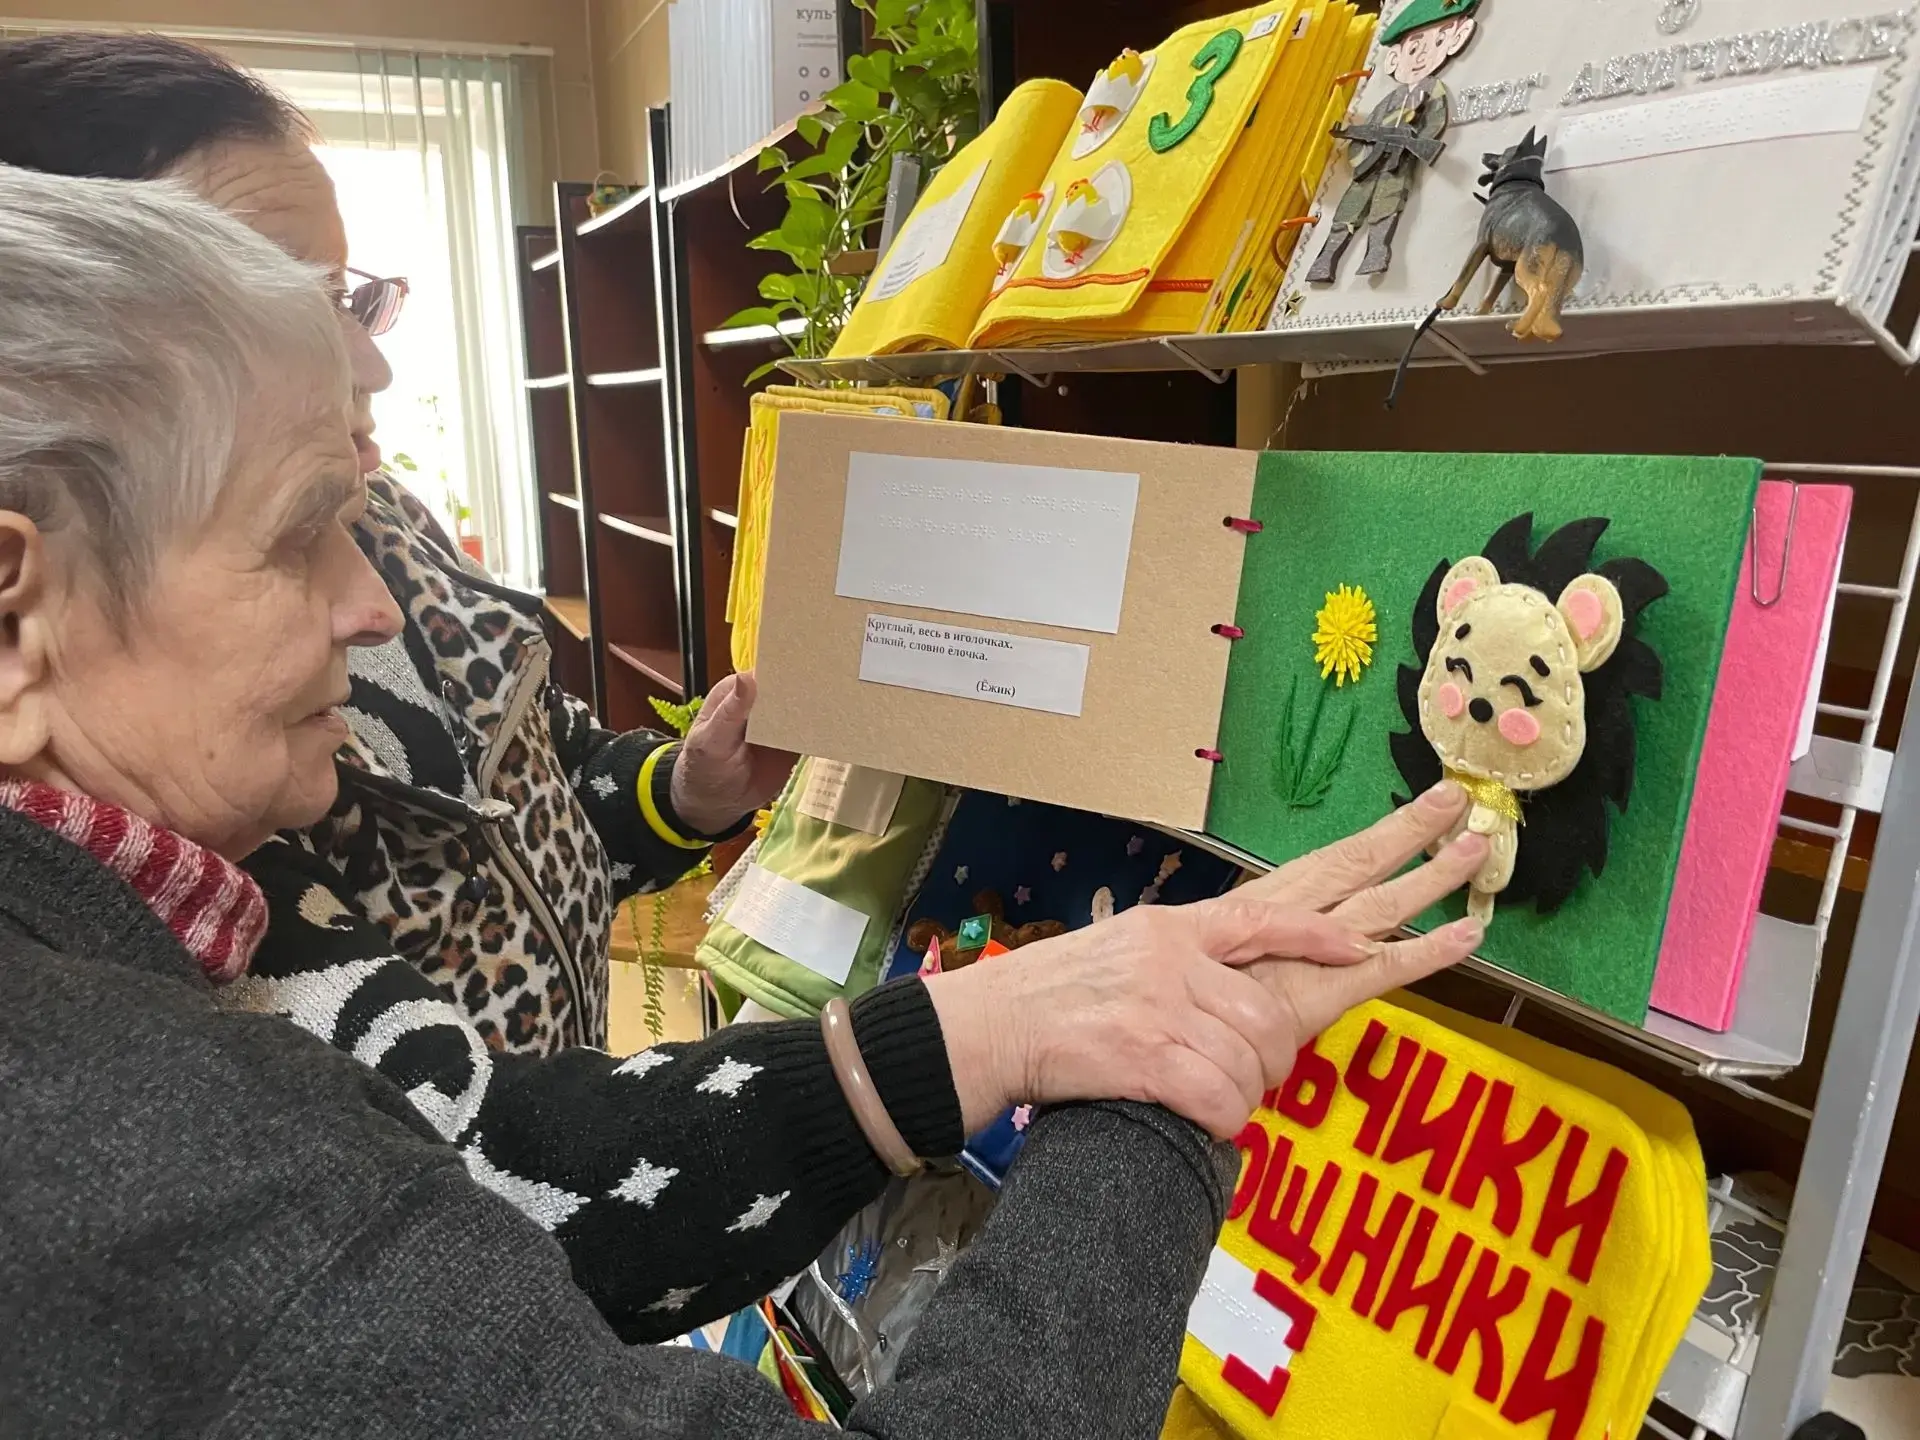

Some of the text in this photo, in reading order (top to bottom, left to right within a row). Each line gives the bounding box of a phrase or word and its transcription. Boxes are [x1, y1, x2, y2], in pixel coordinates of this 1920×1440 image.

[796, 8, 837, 24] куль
[1148, 28, 1244, 154] 3
[865, 632, 988, 661] Колкий, словно ёлочка.
[867, 617, 1013, 649] Круглый, весь в иголочках.
[976, 679, 1016, 698] (Ёжик)
[1262, 1018, 1630, 1286] ЬЧИКИ
